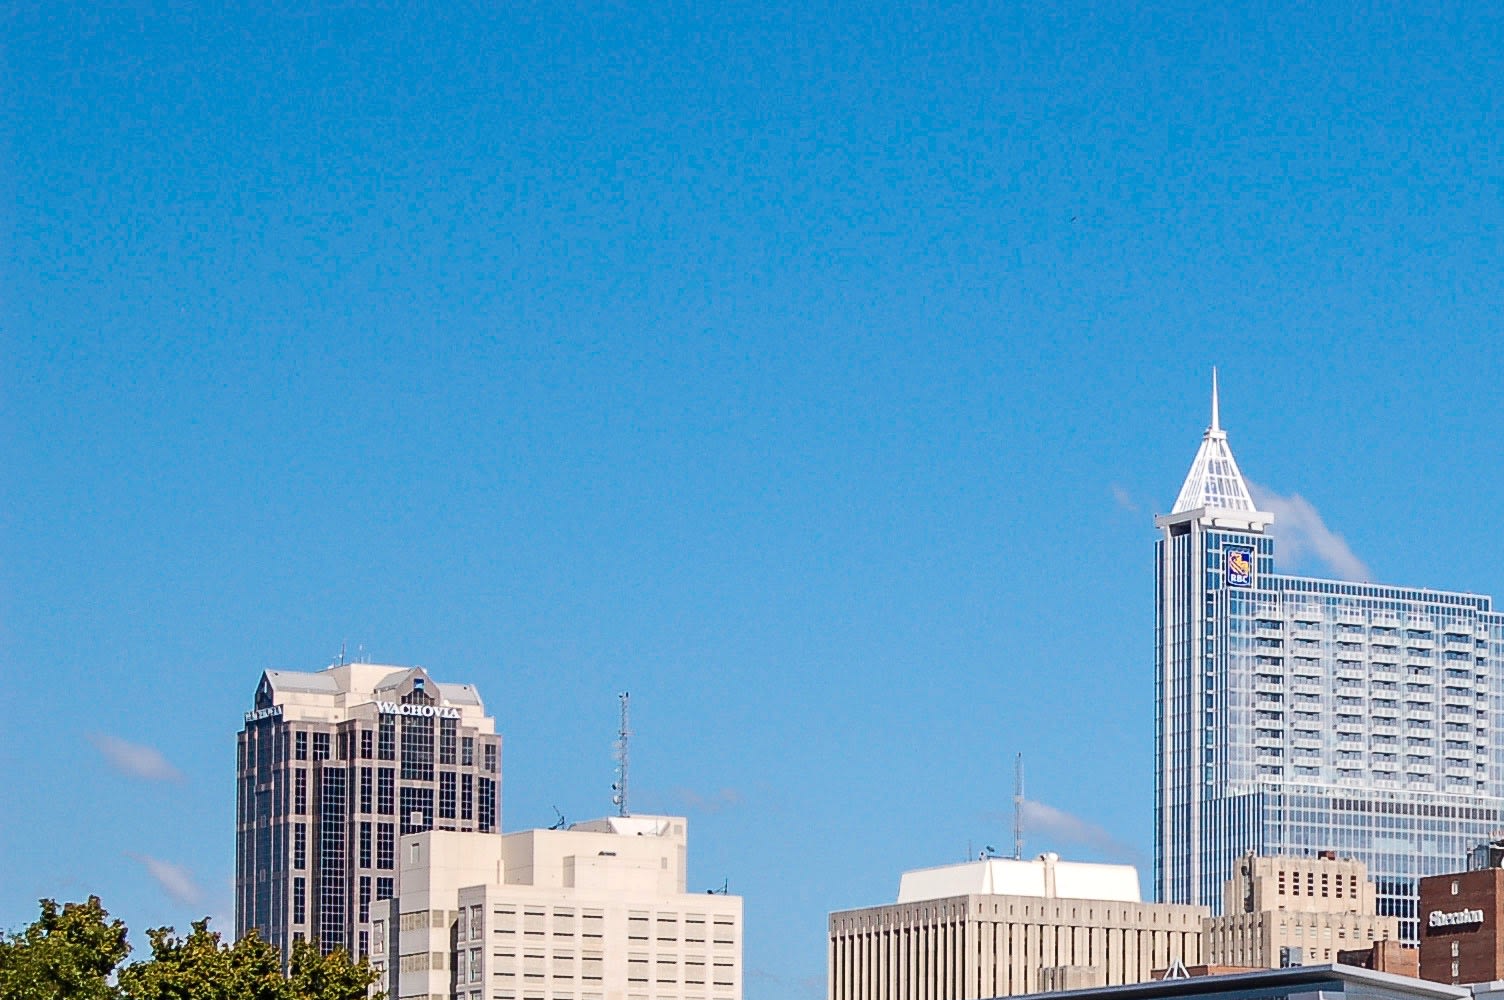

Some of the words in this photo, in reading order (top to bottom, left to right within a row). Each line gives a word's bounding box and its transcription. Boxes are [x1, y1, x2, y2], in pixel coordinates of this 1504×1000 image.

[1231, 574, 1248, 583] RBC
[376, 701, 461, 719] WACHOVIA
[1429, 908, 1484, 927] Sheraton
